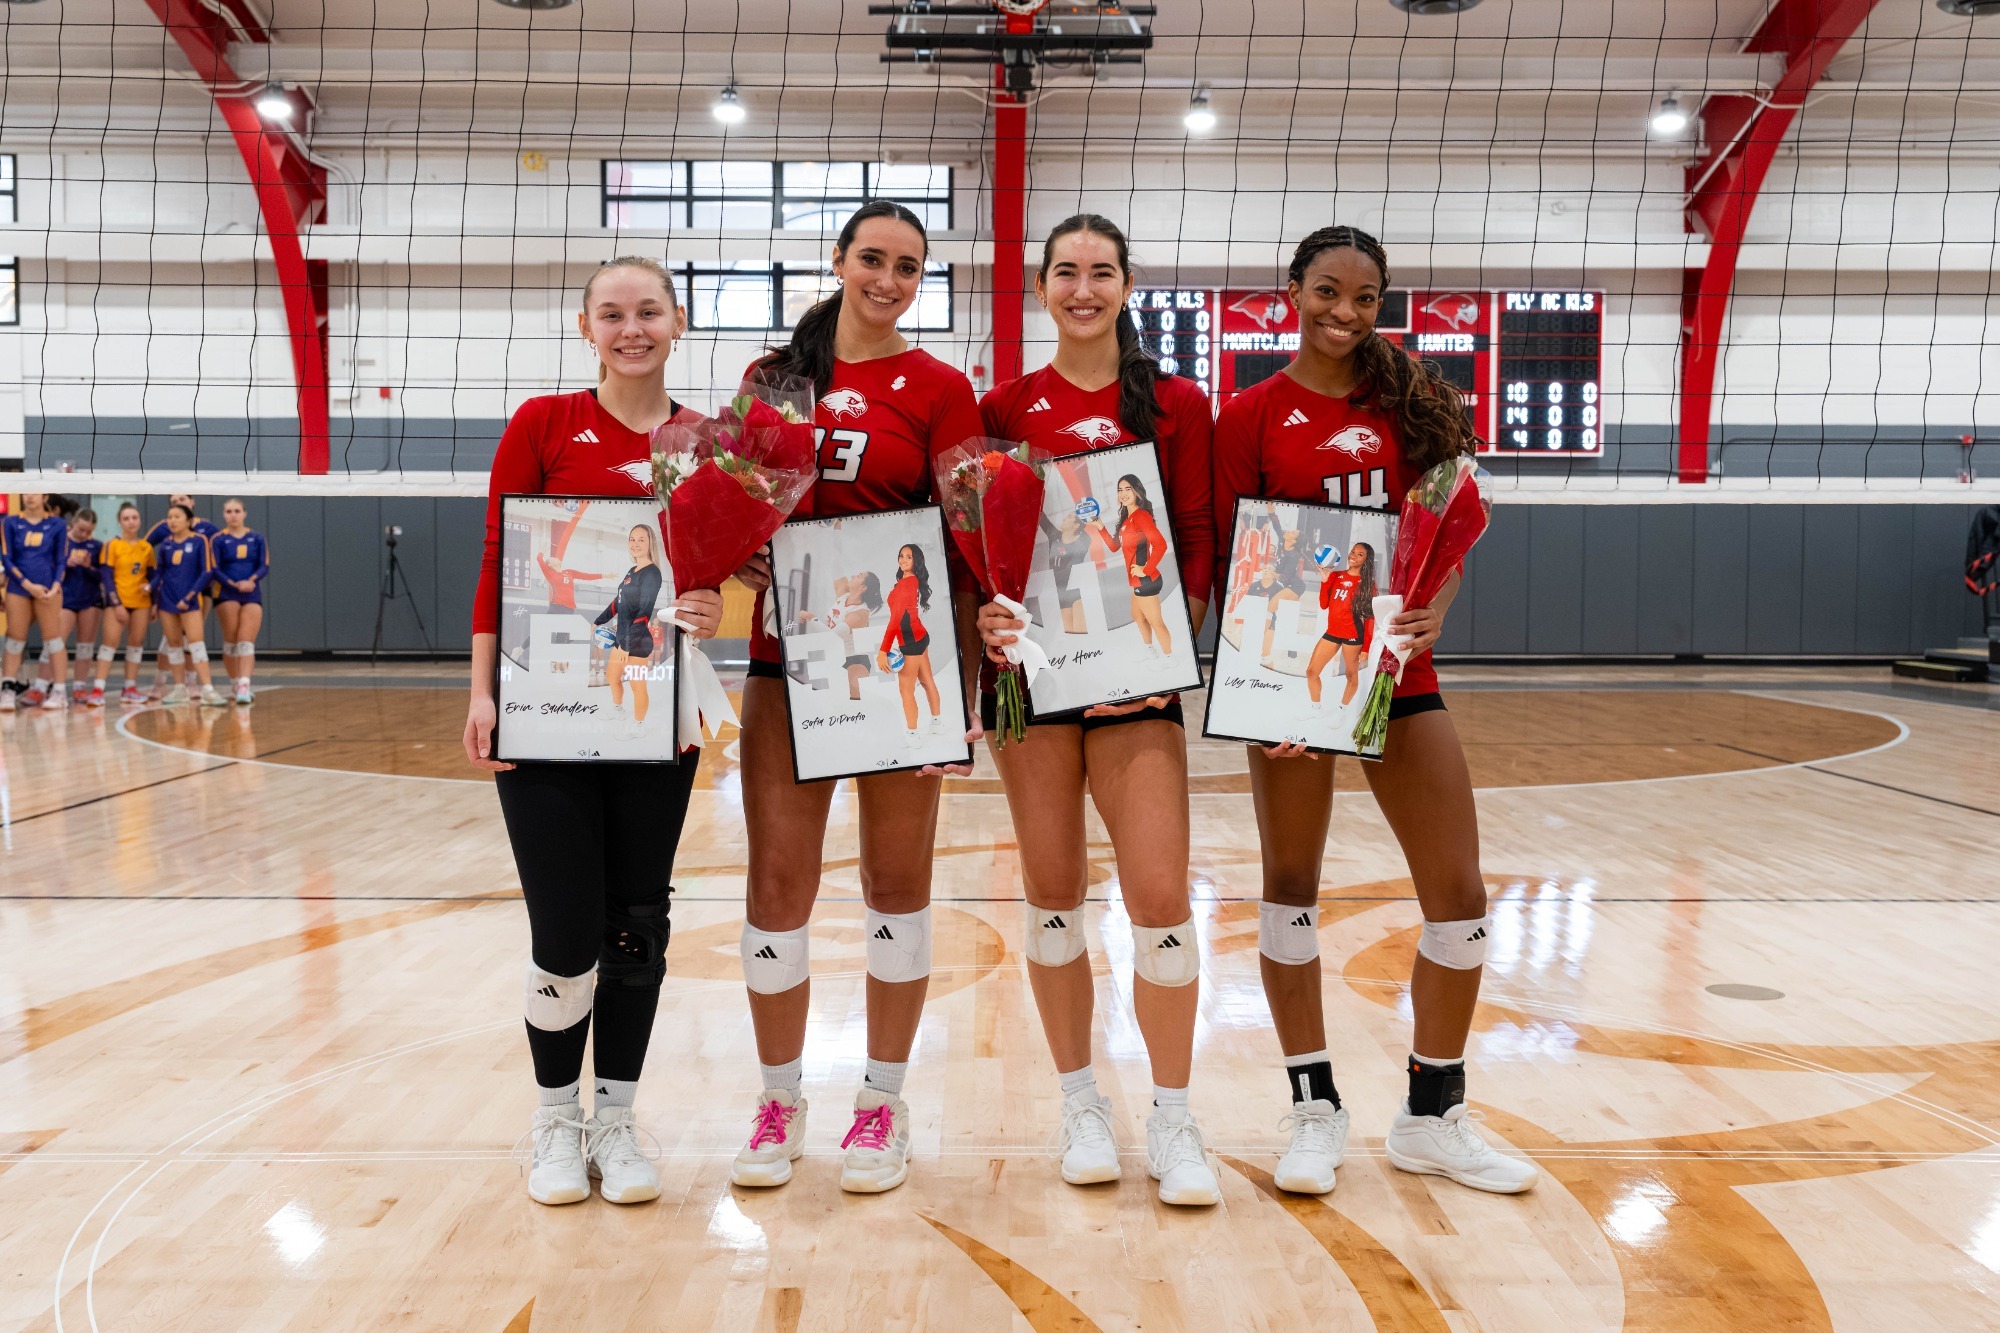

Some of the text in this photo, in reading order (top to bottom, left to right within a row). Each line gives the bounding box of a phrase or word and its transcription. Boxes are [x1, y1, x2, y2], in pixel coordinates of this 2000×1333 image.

[1176, 292, 1205, 308] KLS
[1506, 293, 1594, 311] PLY AC KLS
[1195, 310, 1210, 332] 0
[1195, 334, 1210, 355] 0
[1418, 333, 1474, 351] HUNTER
[1195, 357, 1209, 378] 0
[1507, 382, 1598, 404] 10 0 0
[1507, 405, 1597, 427] 14 0 0
[1513, 428, 1597, 450] 4 0 0
[1322, 467, 1389, 509] 14
[871, 508, 925, 519] VOLLEYBALL
[1333, 588, 1349, 602] 14
[529, 614, 591, 687] 6
[1072, 650, 1104, 665] Horn
[1249, 679, 1283, 691] Thomas
[505, 701, 600, 716] Erin Saunders
[801, 717, 825, 730] Sofia
